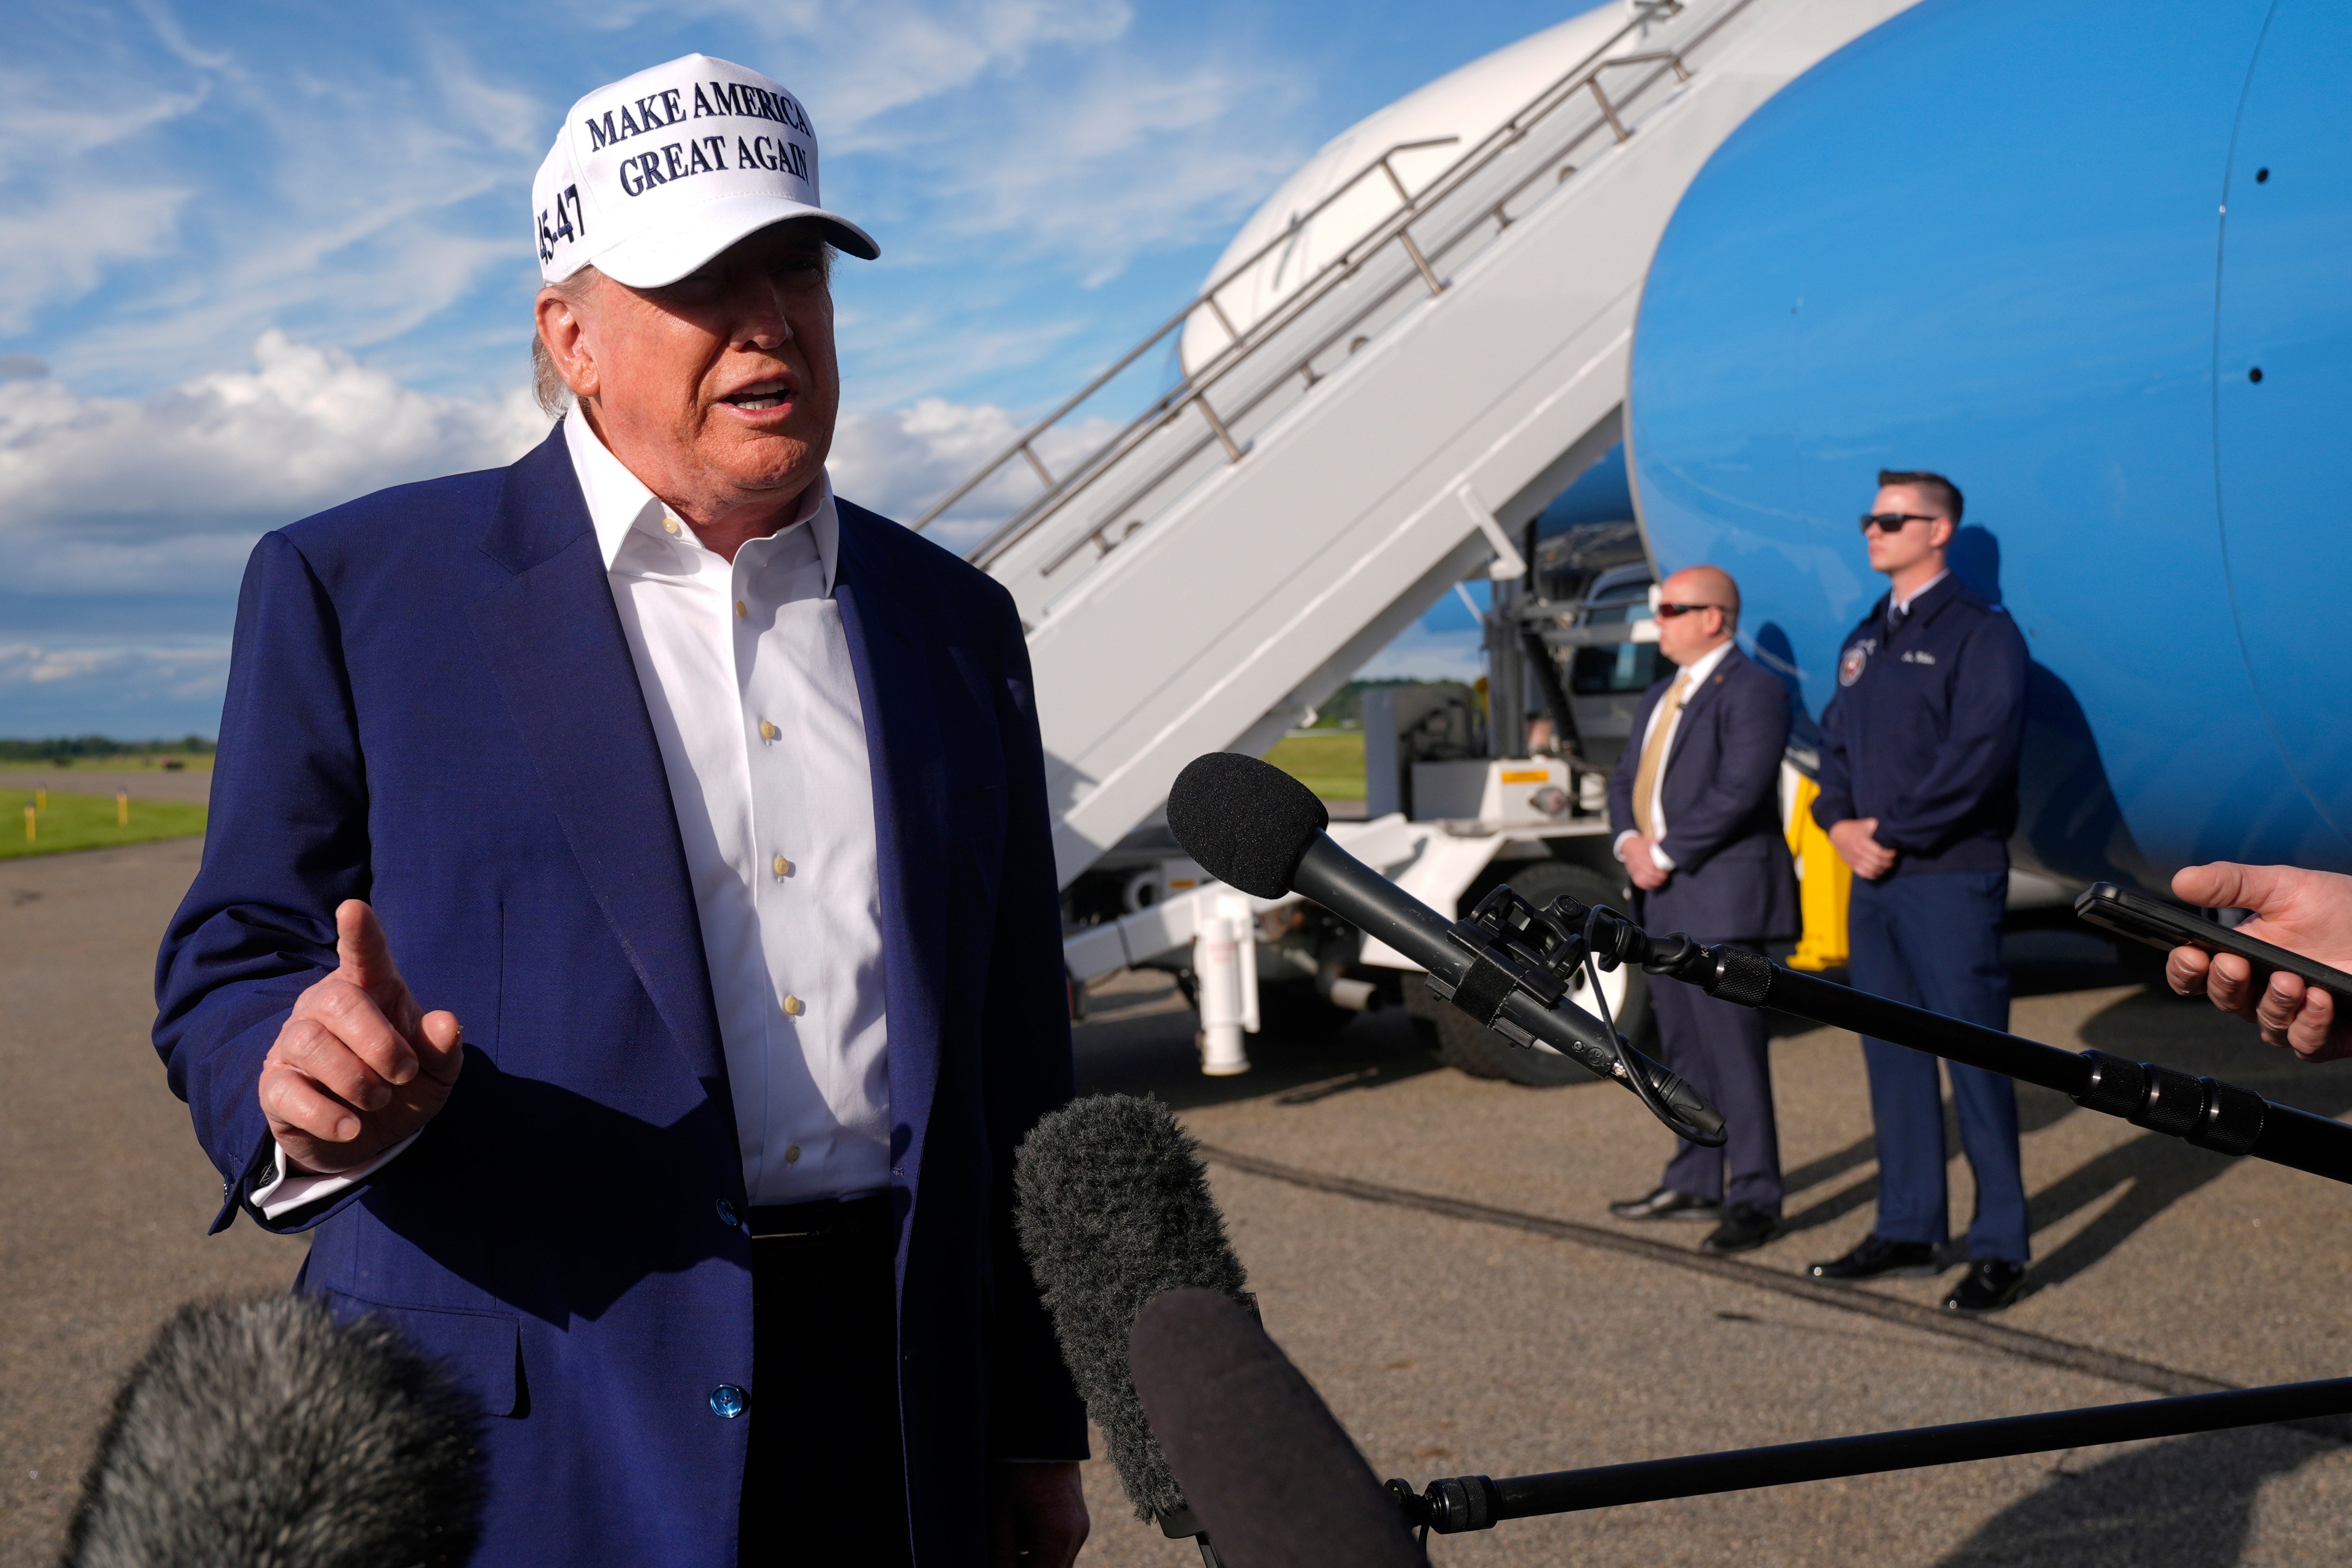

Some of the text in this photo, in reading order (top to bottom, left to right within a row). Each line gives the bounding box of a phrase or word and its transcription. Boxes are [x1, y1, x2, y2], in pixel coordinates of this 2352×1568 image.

[585, 82, 811, 152] MAKE AMERICA
[620, 136, 809, 197] GREAT AGAIN
[537, 183, 585, 265] 45-47
